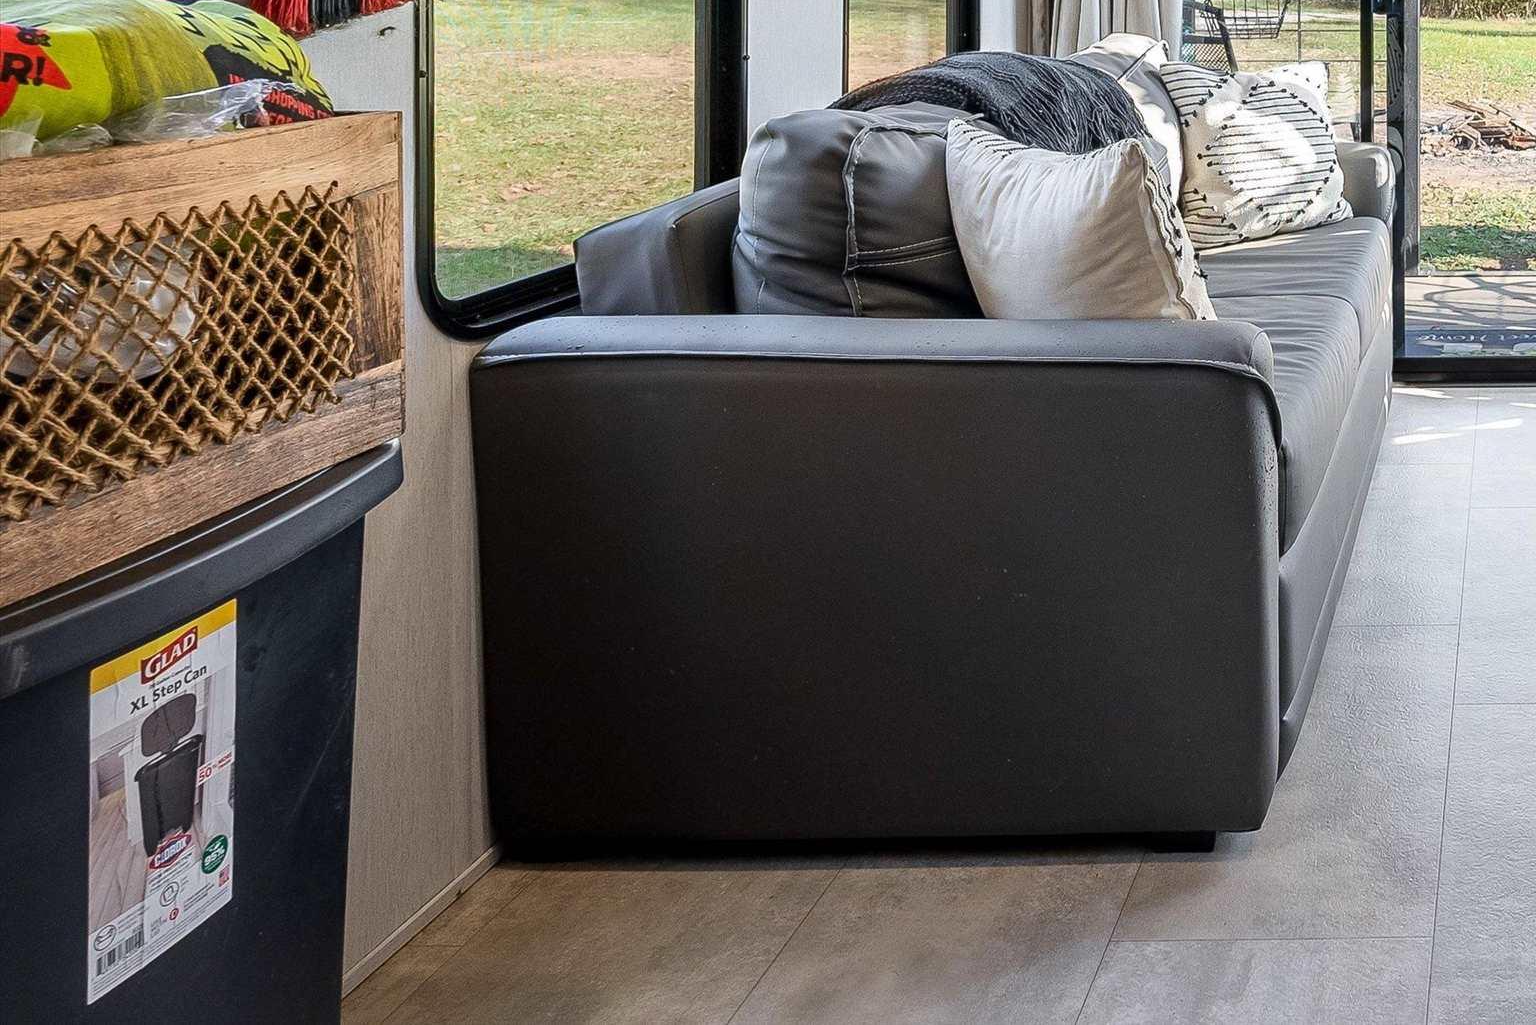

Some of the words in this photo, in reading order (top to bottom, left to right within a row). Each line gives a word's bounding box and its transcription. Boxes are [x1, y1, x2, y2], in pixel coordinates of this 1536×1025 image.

[1415, 332, 1488, 342] Home
[144, 632, 196, 678] GLAD
[130, 695, 149, 715] XL
[152, 679, 183, 703] Step
[184, 665, 207, 684] Can
